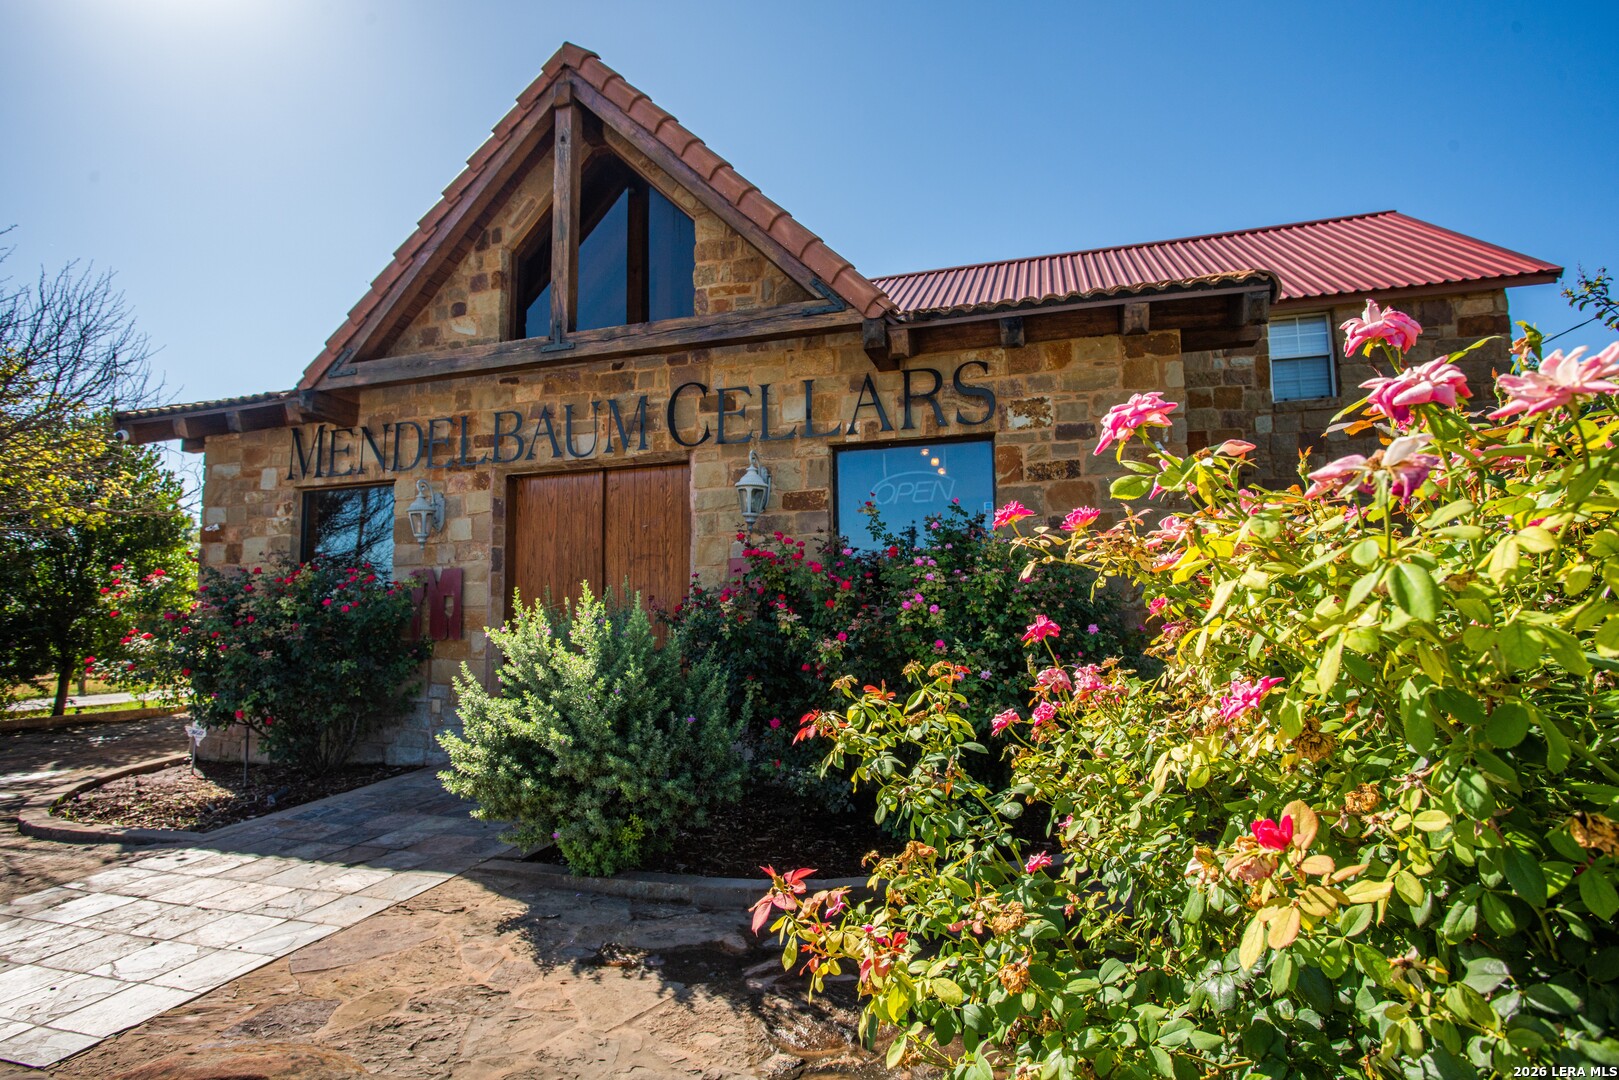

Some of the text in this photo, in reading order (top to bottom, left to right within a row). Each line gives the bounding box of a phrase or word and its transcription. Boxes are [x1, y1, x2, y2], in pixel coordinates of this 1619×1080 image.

[286, 361, 996, 481] MENDELBAUM CELLARS
[875, 480, 956, 505] OPEN
